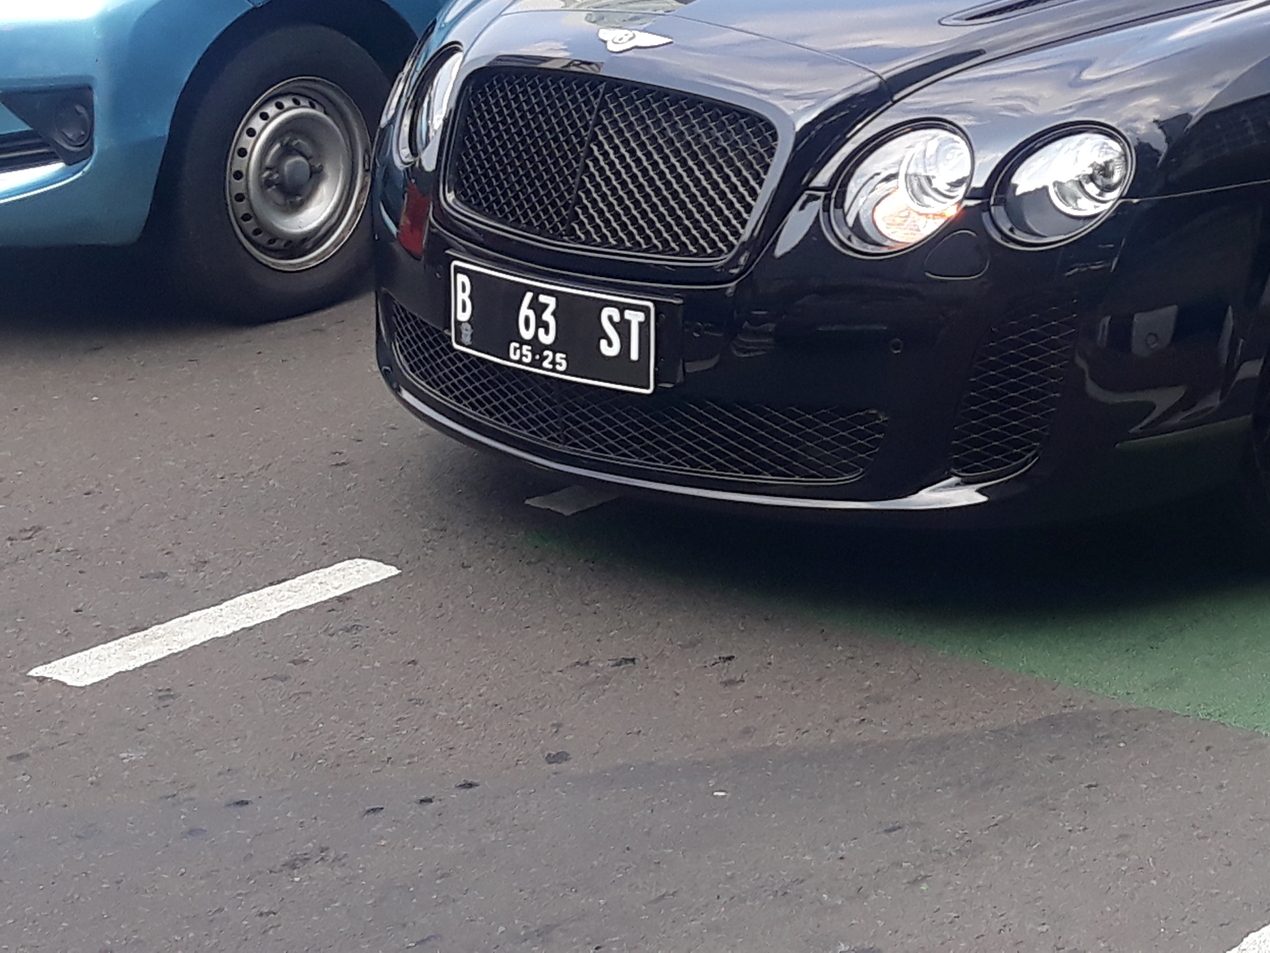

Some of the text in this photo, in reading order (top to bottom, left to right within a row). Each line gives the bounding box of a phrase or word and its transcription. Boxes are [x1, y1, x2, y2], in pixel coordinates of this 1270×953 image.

[456, 273, 646, 362] B 63 ST
